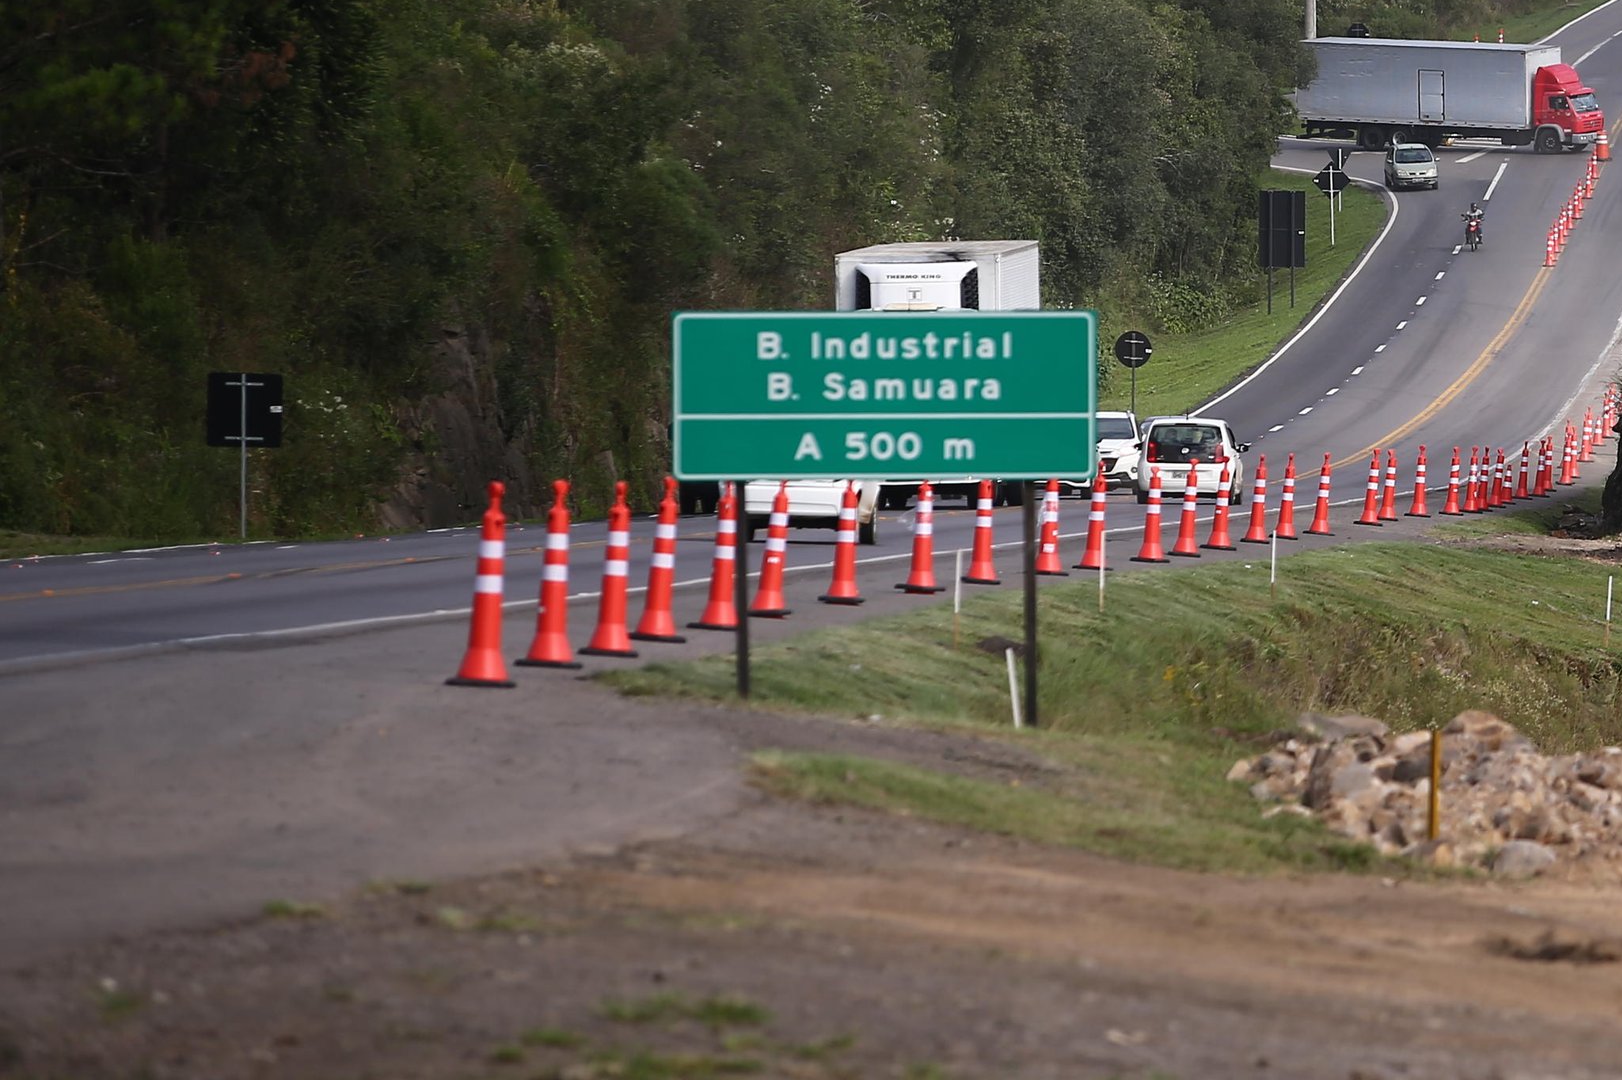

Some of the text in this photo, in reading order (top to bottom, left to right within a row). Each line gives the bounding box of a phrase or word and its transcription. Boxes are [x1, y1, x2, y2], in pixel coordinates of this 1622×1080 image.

[757, 331, 1012, 360] B. Industrial
[767, 372, 1001, 401] B. Samuara
[794, 431, 974, 460] A 500 m
